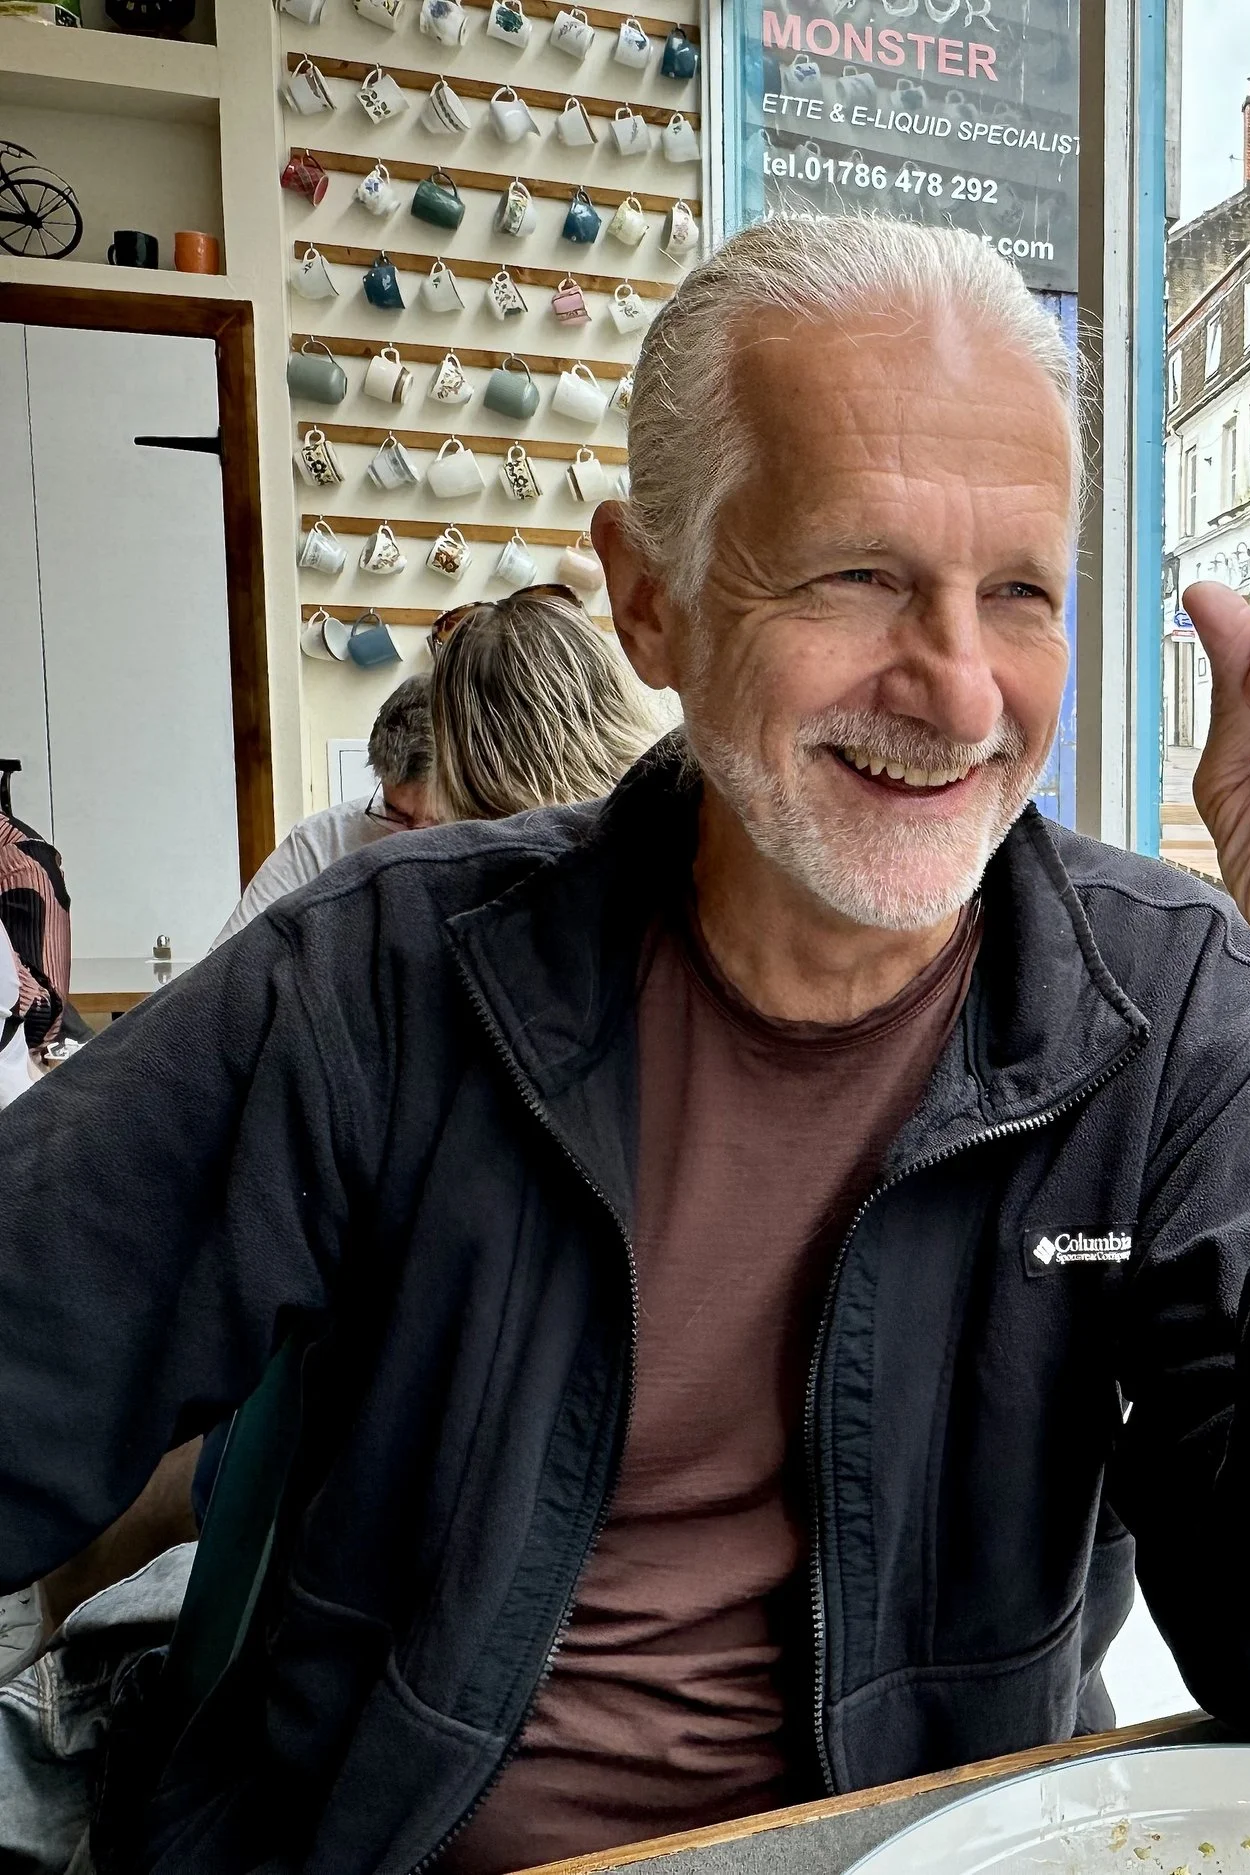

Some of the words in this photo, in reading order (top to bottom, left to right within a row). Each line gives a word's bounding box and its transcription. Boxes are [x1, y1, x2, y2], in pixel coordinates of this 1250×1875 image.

[762, 10, 999, 82] MONSTER
[829, 102, 846, 123] &
[851, 106, 951, 137] E-LIQUID
[762, 151, 887, 190] tel.01786
[894, 168, 943, 197] 478
[951, 175, 998, 204] 292
